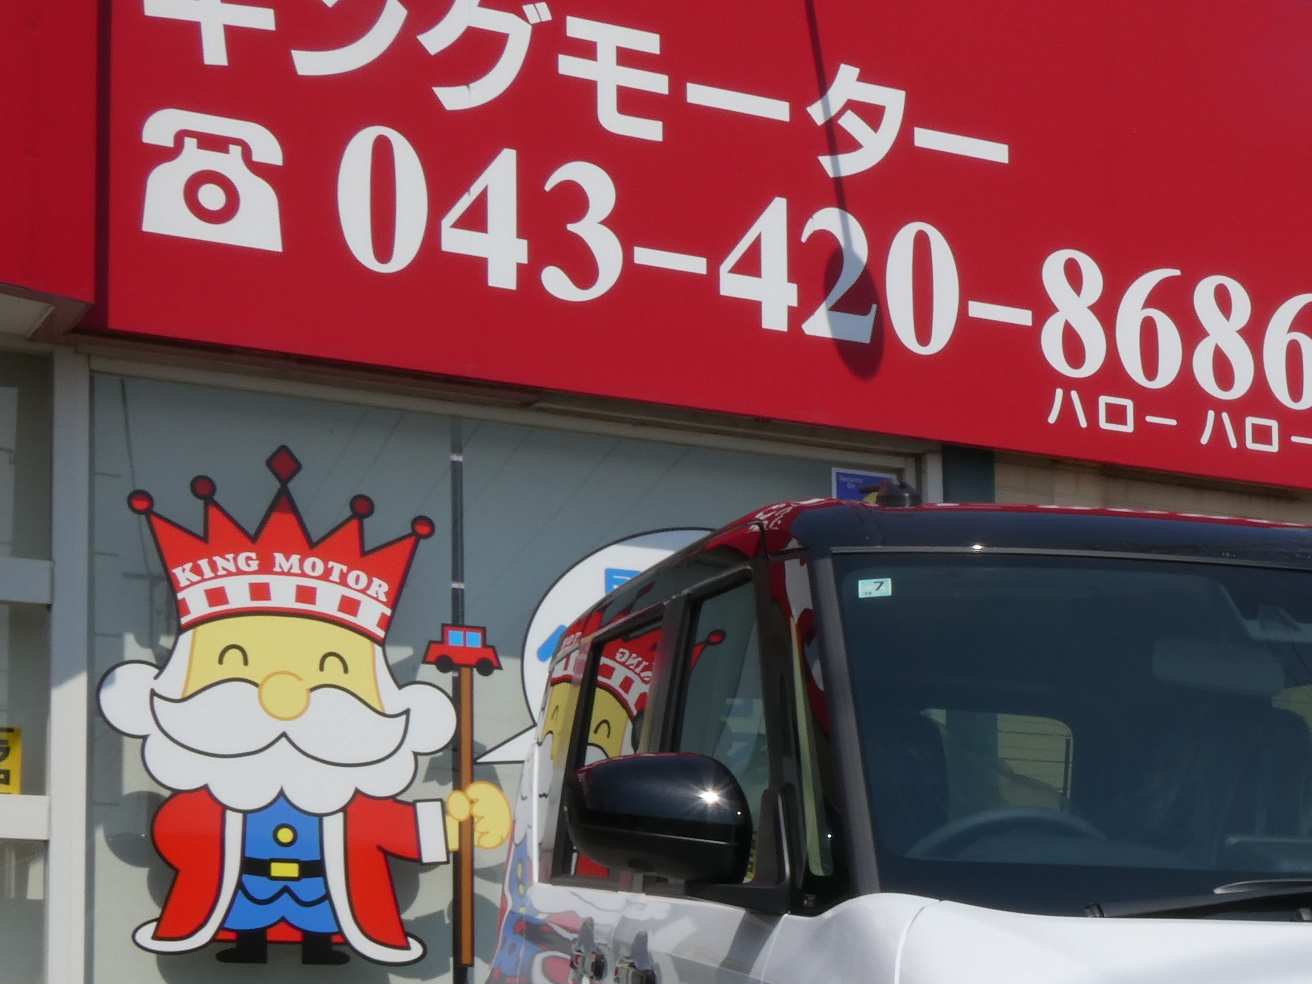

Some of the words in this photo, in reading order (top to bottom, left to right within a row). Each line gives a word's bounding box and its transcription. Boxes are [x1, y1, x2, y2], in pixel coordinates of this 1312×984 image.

[1048, 388, 1178, 433] ハロー
[172, 552, 260, 588] KING
[273, 552, 391, 602] MOTOR
